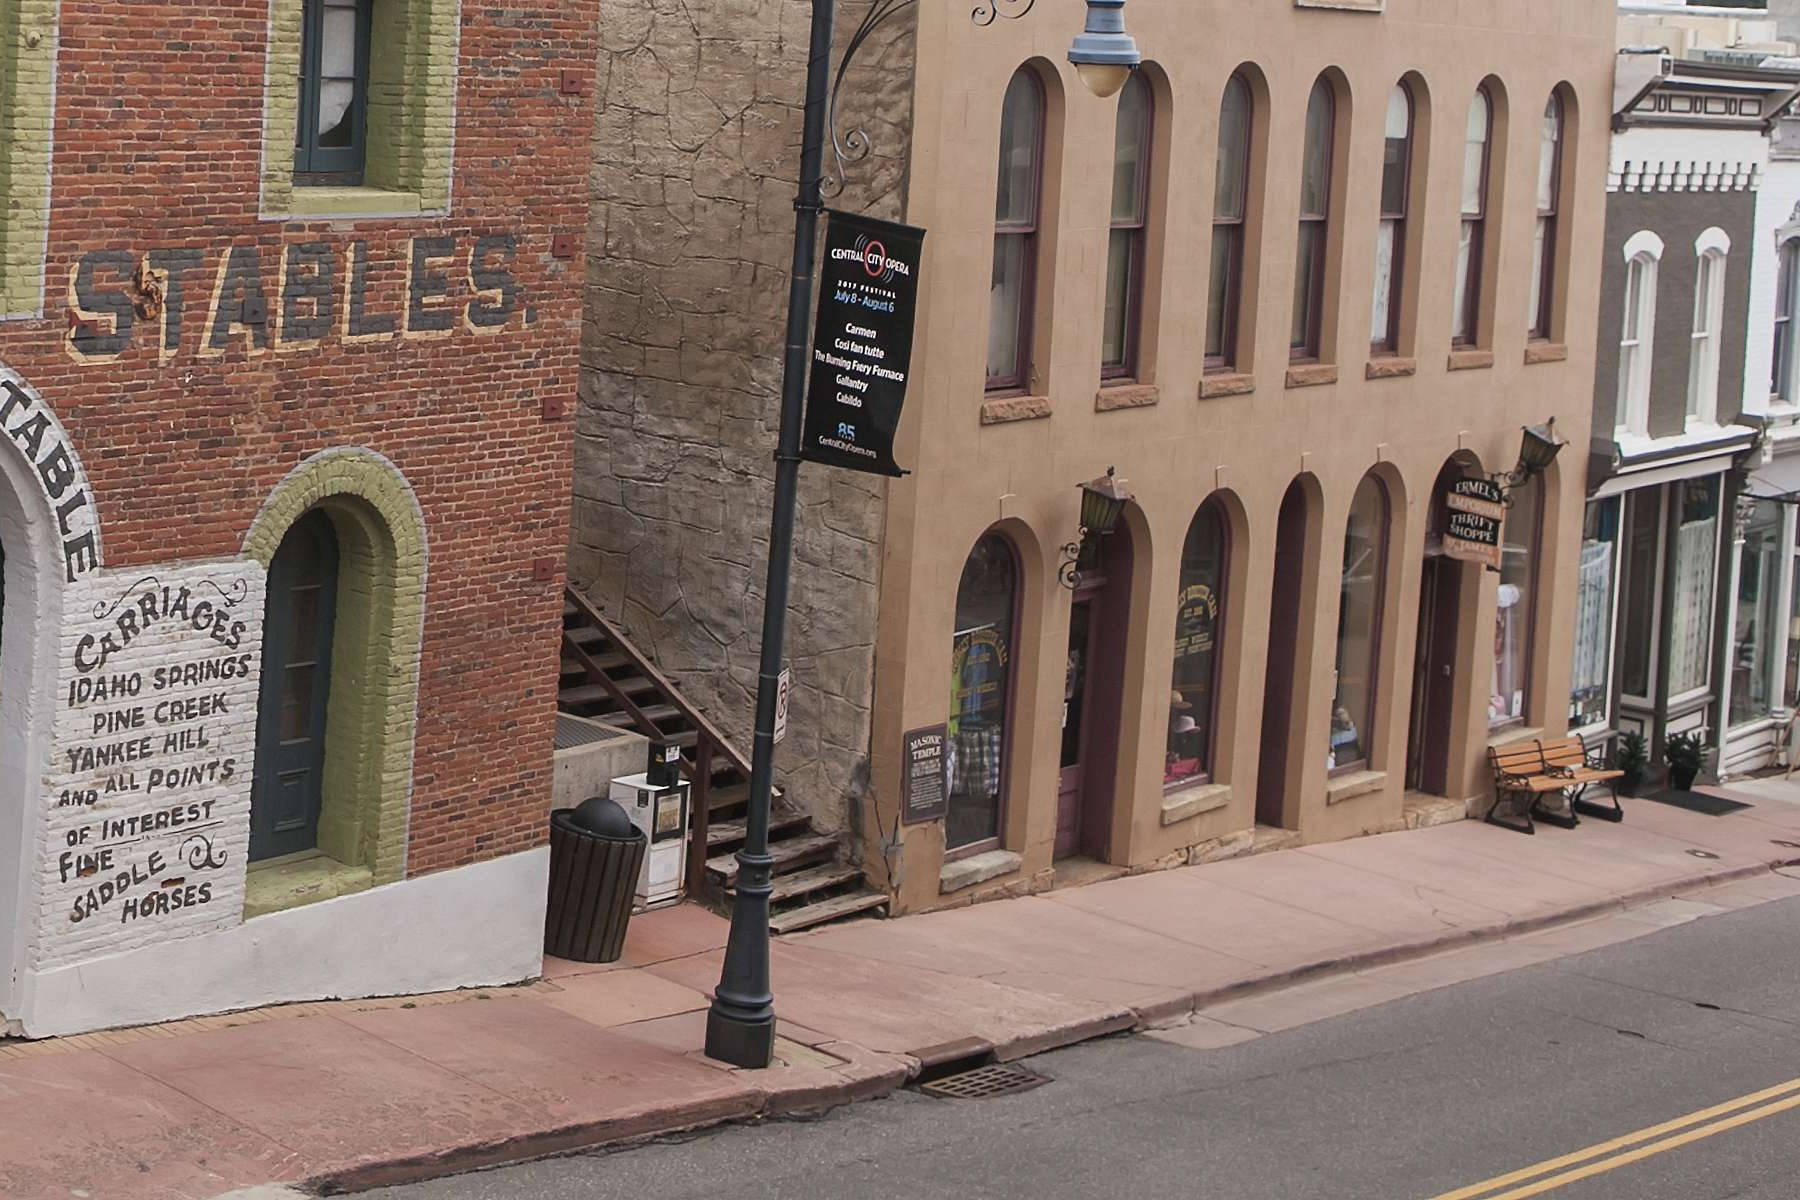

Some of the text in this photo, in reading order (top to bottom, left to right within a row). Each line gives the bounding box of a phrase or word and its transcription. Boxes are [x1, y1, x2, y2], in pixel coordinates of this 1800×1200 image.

[831, 248, 910, 276] CENTRAL CITY OPERA
[834, 289, 851, 304] July
[851, 293, 857, 304] 8
[862, 296, 888, 311] August
[888, 302, 895, 313] 6
[860, 285, 897, 299] FESTIVAL
[845, 322, 877, 339] Carmen
[850, 341, 864, 354] fan
[864, 345, 885, 359] tutte
[815, 349, 905, 382] The Burning Fiery Furnace
[836, 374, 869, 393] Gallantry
[836, 392, 862, 408] Cabildo
[1449, 523, 1494, 542] SHOPPE
[1450, 513, 1495, 532] THRIFT
[74, 585, 247, 673] CARRIAGES
[68, 653, 252, 707] IDAHO SPRINGS
[93, 691, 229, 735] PINE CREEK
[66, 726, 210, 775] YANKEE HILL
[58, 758, 237, 808] AND ALL POINTS
[66, 800, 217, 847] OF INTEREST
[69, 850, 167, 923] SADDLE
[121, 881, 213, 924] HORSES
